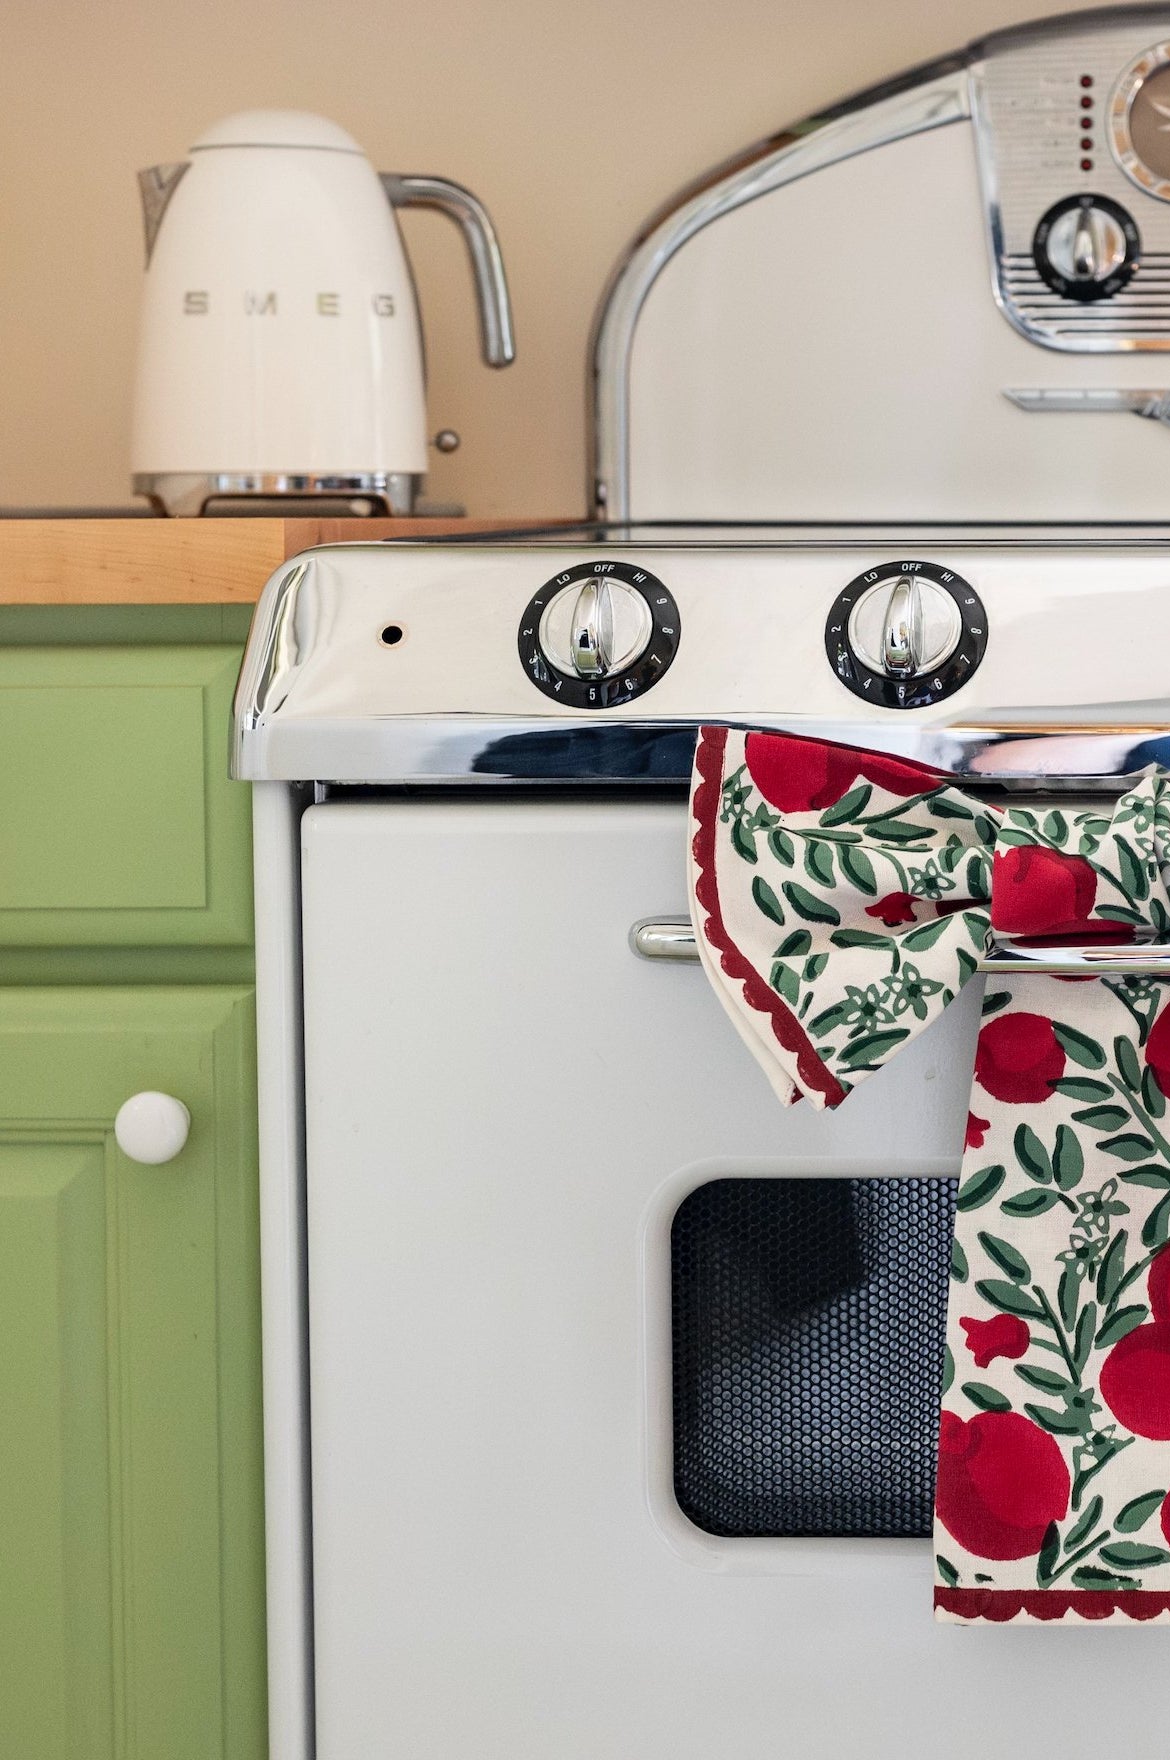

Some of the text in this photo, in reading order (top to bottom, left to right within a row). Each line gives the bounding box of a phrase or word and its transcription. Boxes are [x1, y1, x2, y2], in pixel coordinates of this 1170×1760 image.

[182, 290, 397, 318] SMEG
[594, 564, 616, 573] OFF
[902, 563, 922, 572] OFF
[556, 574, 571, 585] LO
[633, 572, 647, 583] HI
[864, 571, 878, 583] LO
[941, 571, 954, 583] HI
[656, 597, 668, 605] 9
[523, 628, 533, 636] 2
[662, 627, 674, 635] 8
[831, 625, 842, 633] 2
[970, 627, 982, 635] 8
[651, 653, 662, 664] 7
[837, 652, 850, 662] 3
[960, 653, 971, 664] 7
[554, 680, 563, 692] 4
[624, 678, 634, 691] 6
[864, 678, 872, 689] 4
[934, 678, 943, 690] 6
[590, 688, 596, 700] 5
[899, 687, 905, 698] 5
